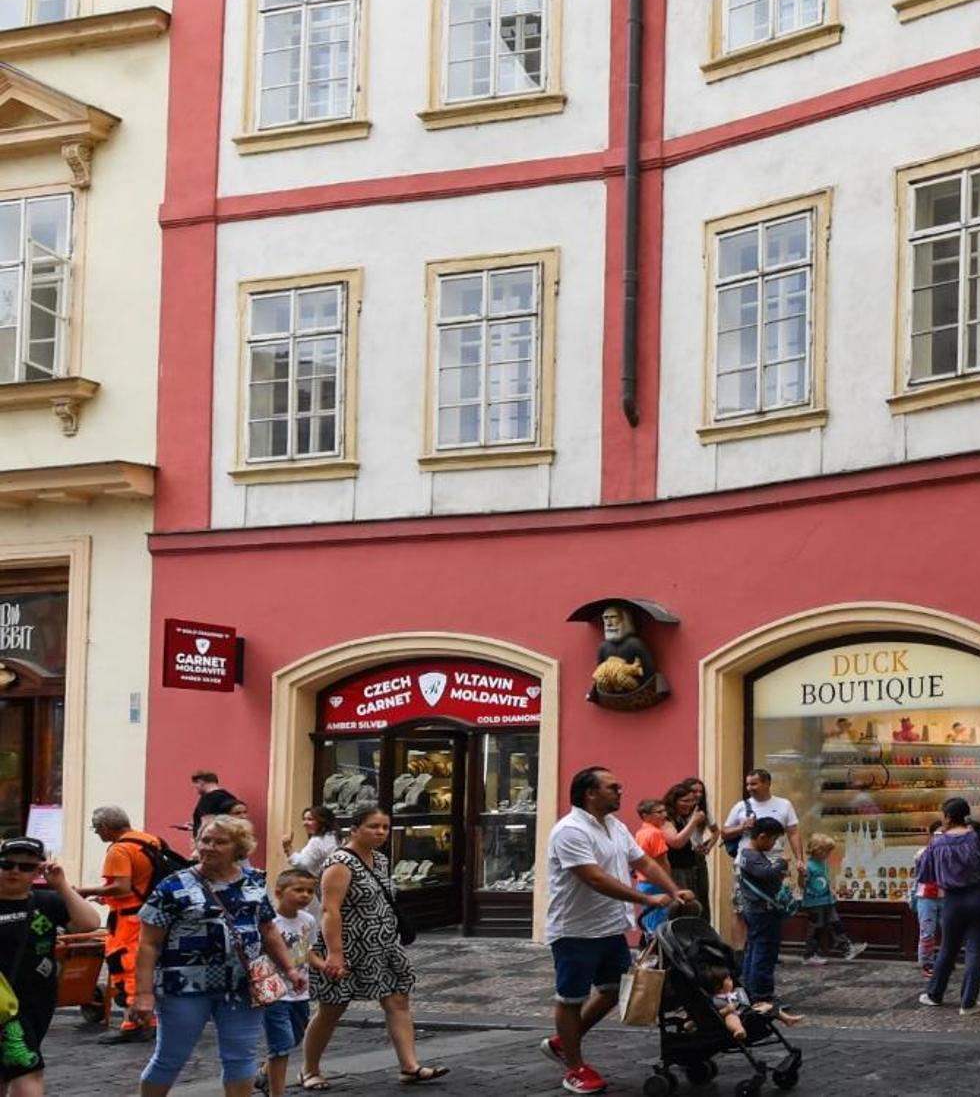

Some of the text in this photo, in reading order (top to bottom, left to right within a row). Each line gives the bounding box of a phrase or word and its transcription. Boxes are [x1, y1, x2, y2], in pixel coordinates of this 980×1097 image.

[175, 664, 226, 676] MOLDAVITE
[176, 653, 226, 668] GARNET
[832, 650, 908, 676] DUCK
[364, 675, 411, 698] CZECH
[454, 672, 514, 691] VLTAVIN
[801, 675, 944, 705] BOUTIQUE
[356, 691, 412, 716] GARNET
[450, 688, 529, 708] MOLDAVITE
[326, 719, 388, 730] AMBER SILVER
[477, 715, 500, 723] GOLD
